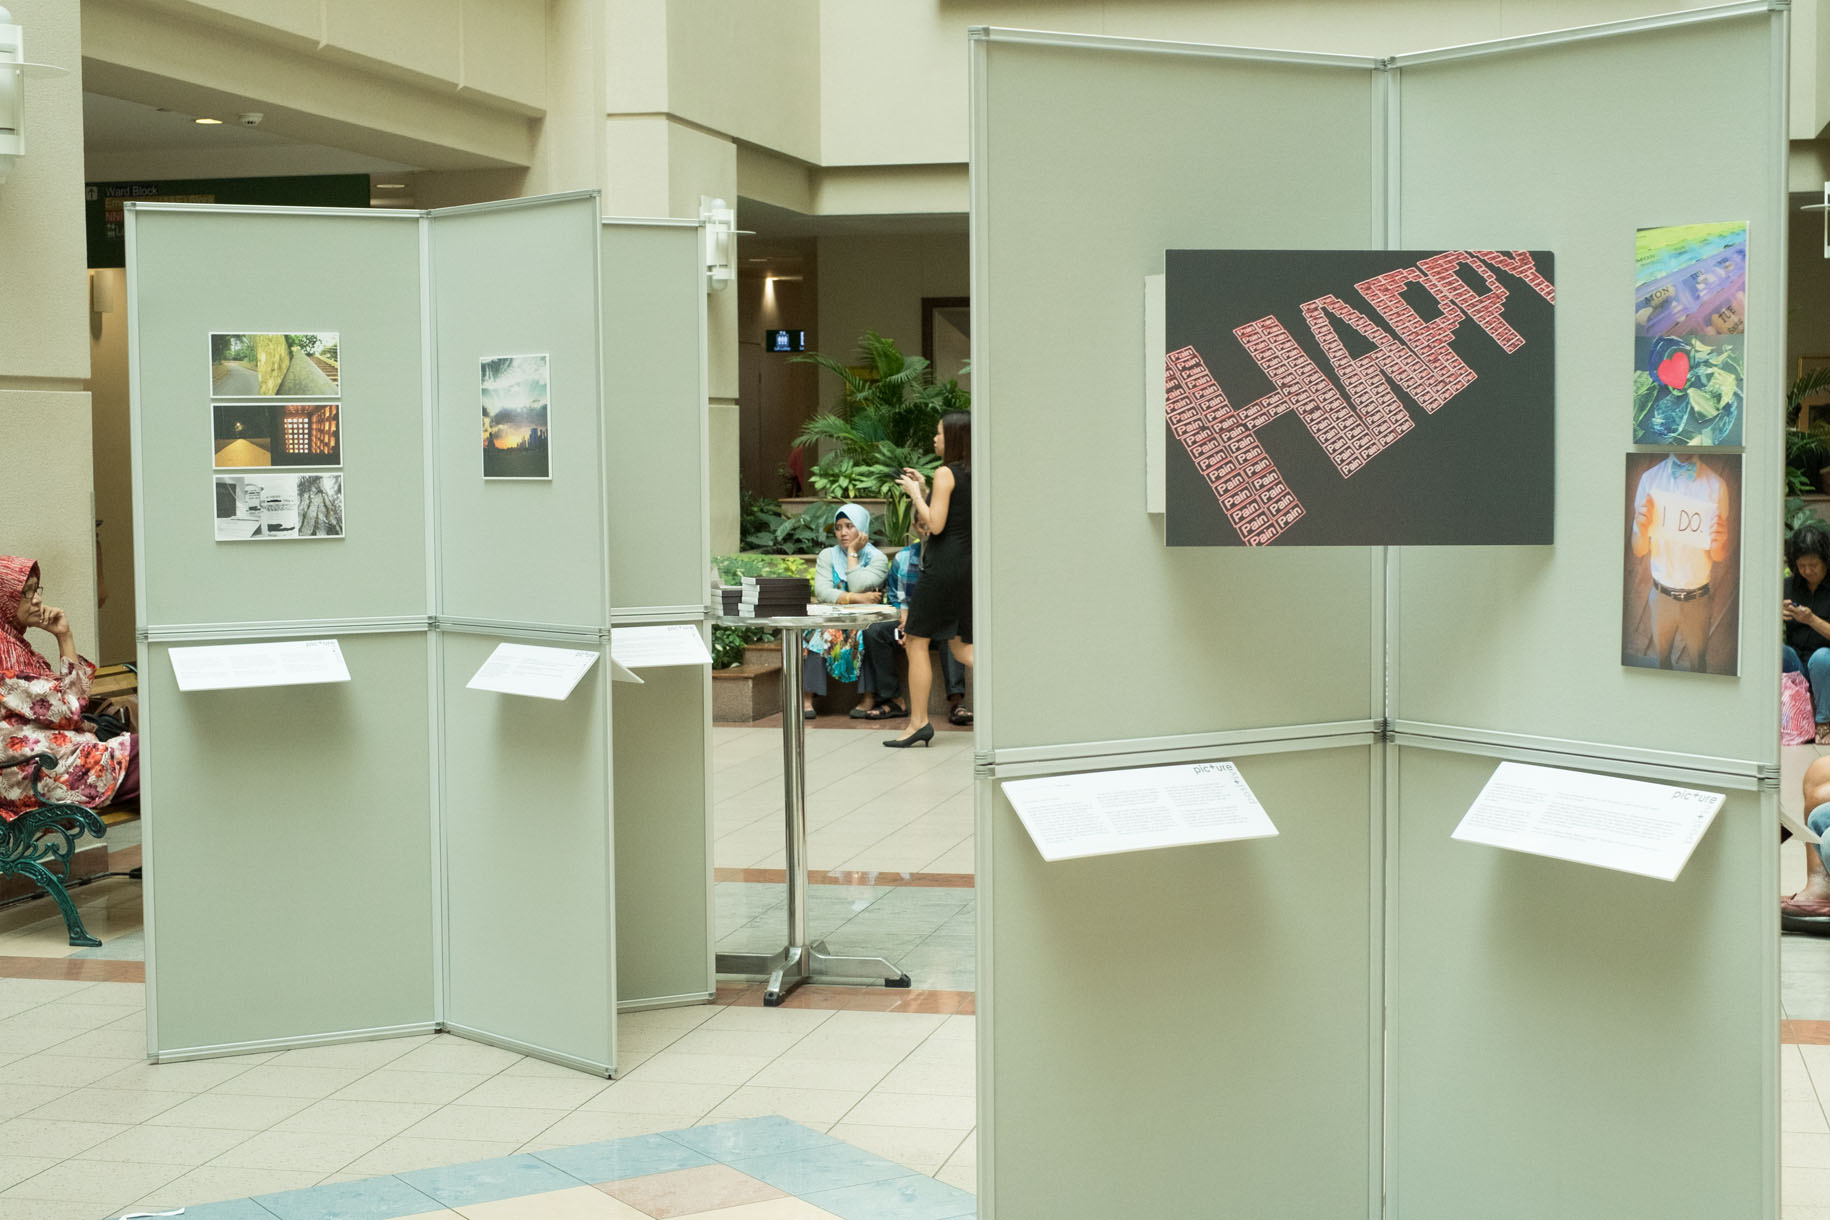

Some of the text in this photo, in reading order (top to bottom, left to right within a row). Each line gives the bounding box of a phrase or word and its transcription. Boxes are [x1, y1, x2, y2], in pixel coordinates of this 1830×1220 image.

[105, 185, 158, 196] Ward Block
[1644, 285, 1669, 304] MON
[1718, 304, 1736, 323] TUE
[1170, 348, 1193, 361] Pain
[1176, 358, 1199, 370] Pain
[1182, 366, 1204, 378] Pain
[1187, 376, 1210, 388] Pain
[1194, 386, 1218, 399] Pain
[1261, 393, 1282, 407] Pain
[1166, 399, 1190, 413] Pain
[1201, 396, 1223, 410] Pain
[1269, 402, 1290, 416] Pain
[1171, 409, 1196, 423] Pain
[1207, 406, 1230, 421] Pain
[1239, 405, 1261, 419] Pain
[1304, 410, 1324, 422] Pain
[1330, 408, 1350, 421] Pain
[1177, 420, 1203, 435] Pain
[1213, 416, 1237, 432] Pain
[1247, 415, 1268, 429] Pain
[1311, 419, 1331, 433] Pain
[1338, 417, 1357, 430] Pain
[1185, 429, 1211, 445] Pain
[1221, 426, 1245, 441] Pain
[1319, 428, 1339, 442] Pain
[1345, 426, 1364, 439] Pain
[1192, 439, 1219, 457] Pain
[1230, 436, 1254, 452] Pain
[1326, 437, 1347, 453] Pain
[1352, 434, 1372, 449] Pain
[1237, 448, 1261, 463] Pain
[1334, 448, 1355, 463] Pain
[1361, 442, 1380, 459] Pain
[1200, 452, 1226, 470] Pain
[1245, 459, 1269, 476] Pain
[1342, 458, 1362, 474] Pain
[1208, 463, 1235, 481] Pain
[1217, 475, 1243, 494] Pain
[1254, 472, 1278, 489] Pain
[1224, 488, 1250, 509] Pain
[1261, 483, 1285, 502] Pain
[1233, 502, 1259, 522] Pain
[1270, 494, 1293, 515] Pain
[1278, 506, 1301, 527] Pain
[1241, 515, 1268, 535] Pain
[1251, 527, 1277, 546] Pain
